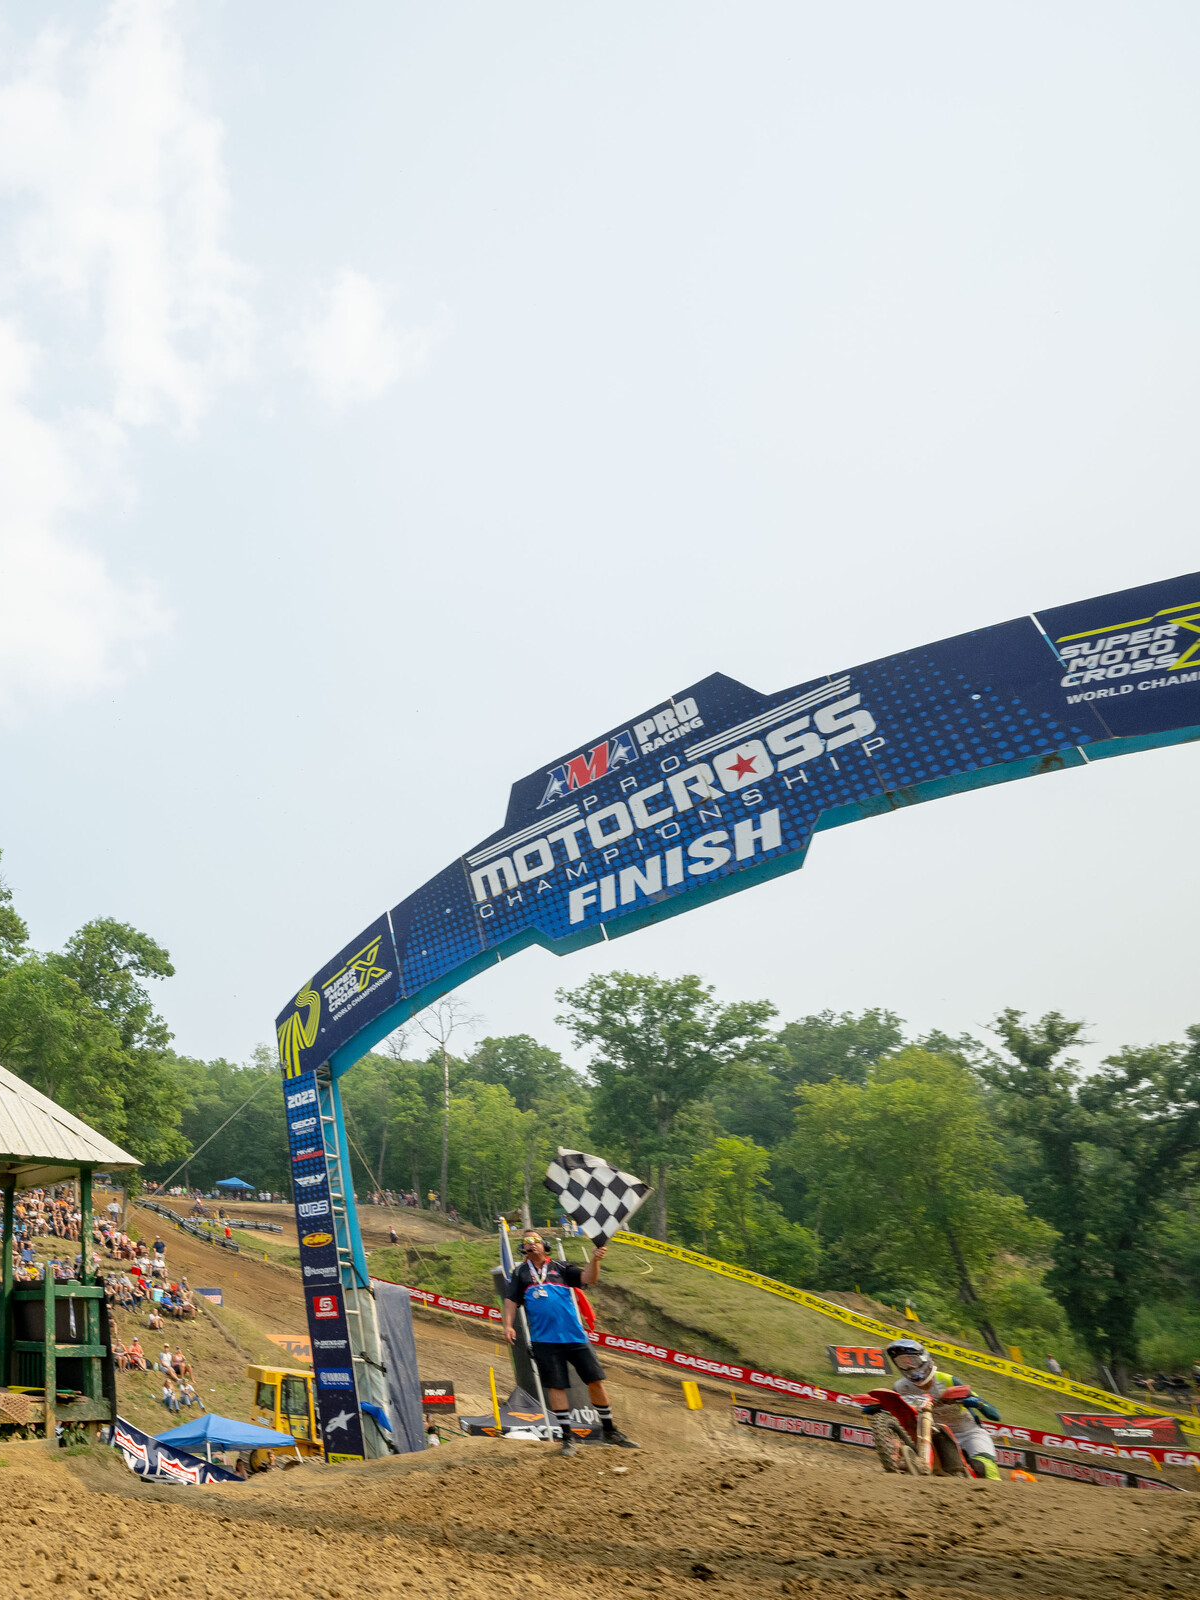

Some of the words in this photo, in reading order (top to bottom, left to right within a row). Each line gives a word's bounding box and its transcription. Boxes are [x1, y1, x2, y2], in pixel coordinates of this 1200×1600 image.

[1058, 623, 1180, 661] SUPER
[1066, 638, 1176, 673] MOTO
[1060, 653, 1180, 687] CROSS
[1066, 684, 1135, 705] WORLD
[641, 716, 704, 755] RACING
[536, 729, 640, 810] AMA
[633, 697, 700, 743] PRO
[470, 692, 877, 901] MOTOCROSS
[479, 736, 886, 918] CHAMPIONSHIP
[569, 808, 782, 925] FINISH
[323, 967, 357, 998] SUPER
[328, 976, 357, 1004] MOTO
[328, 982, 361, 1013] CROSS
[351, 971, 393, 1007] CHAMPIONSHIP
[287, 1089, 316, 1109] 2023
[291, 1117, 317, 1130] GEICO
[298, 1200, 329, 1217] WPS
[681, 1250, 718, 1269] SUZUKI
[720, 1264, 760, 1283] SUZUKI
[761, 1278, 802, 1299] SUZUKI
[804, 1296, 848, 1319] SUZUKI
[850, 1315, 897, 1338] SUZUKI
[953, 1348, 1006, 1371] SUZUKI
[1010, 1365, 1066, 1389] SUZUKI
[1070, 1384, 1132, 1411] SUZUKI
[835, 1346, 885, 1368] ETS
[438, 1297, 484, 1315] GASGAS
[605, 1336, 668, 1359] GASGAS
[674, 1353, 743, 1379] GASGAS
[750, 1372, 828, 1401] GASGAS
[1042, 1435, 1156, 1460] GASGAS
